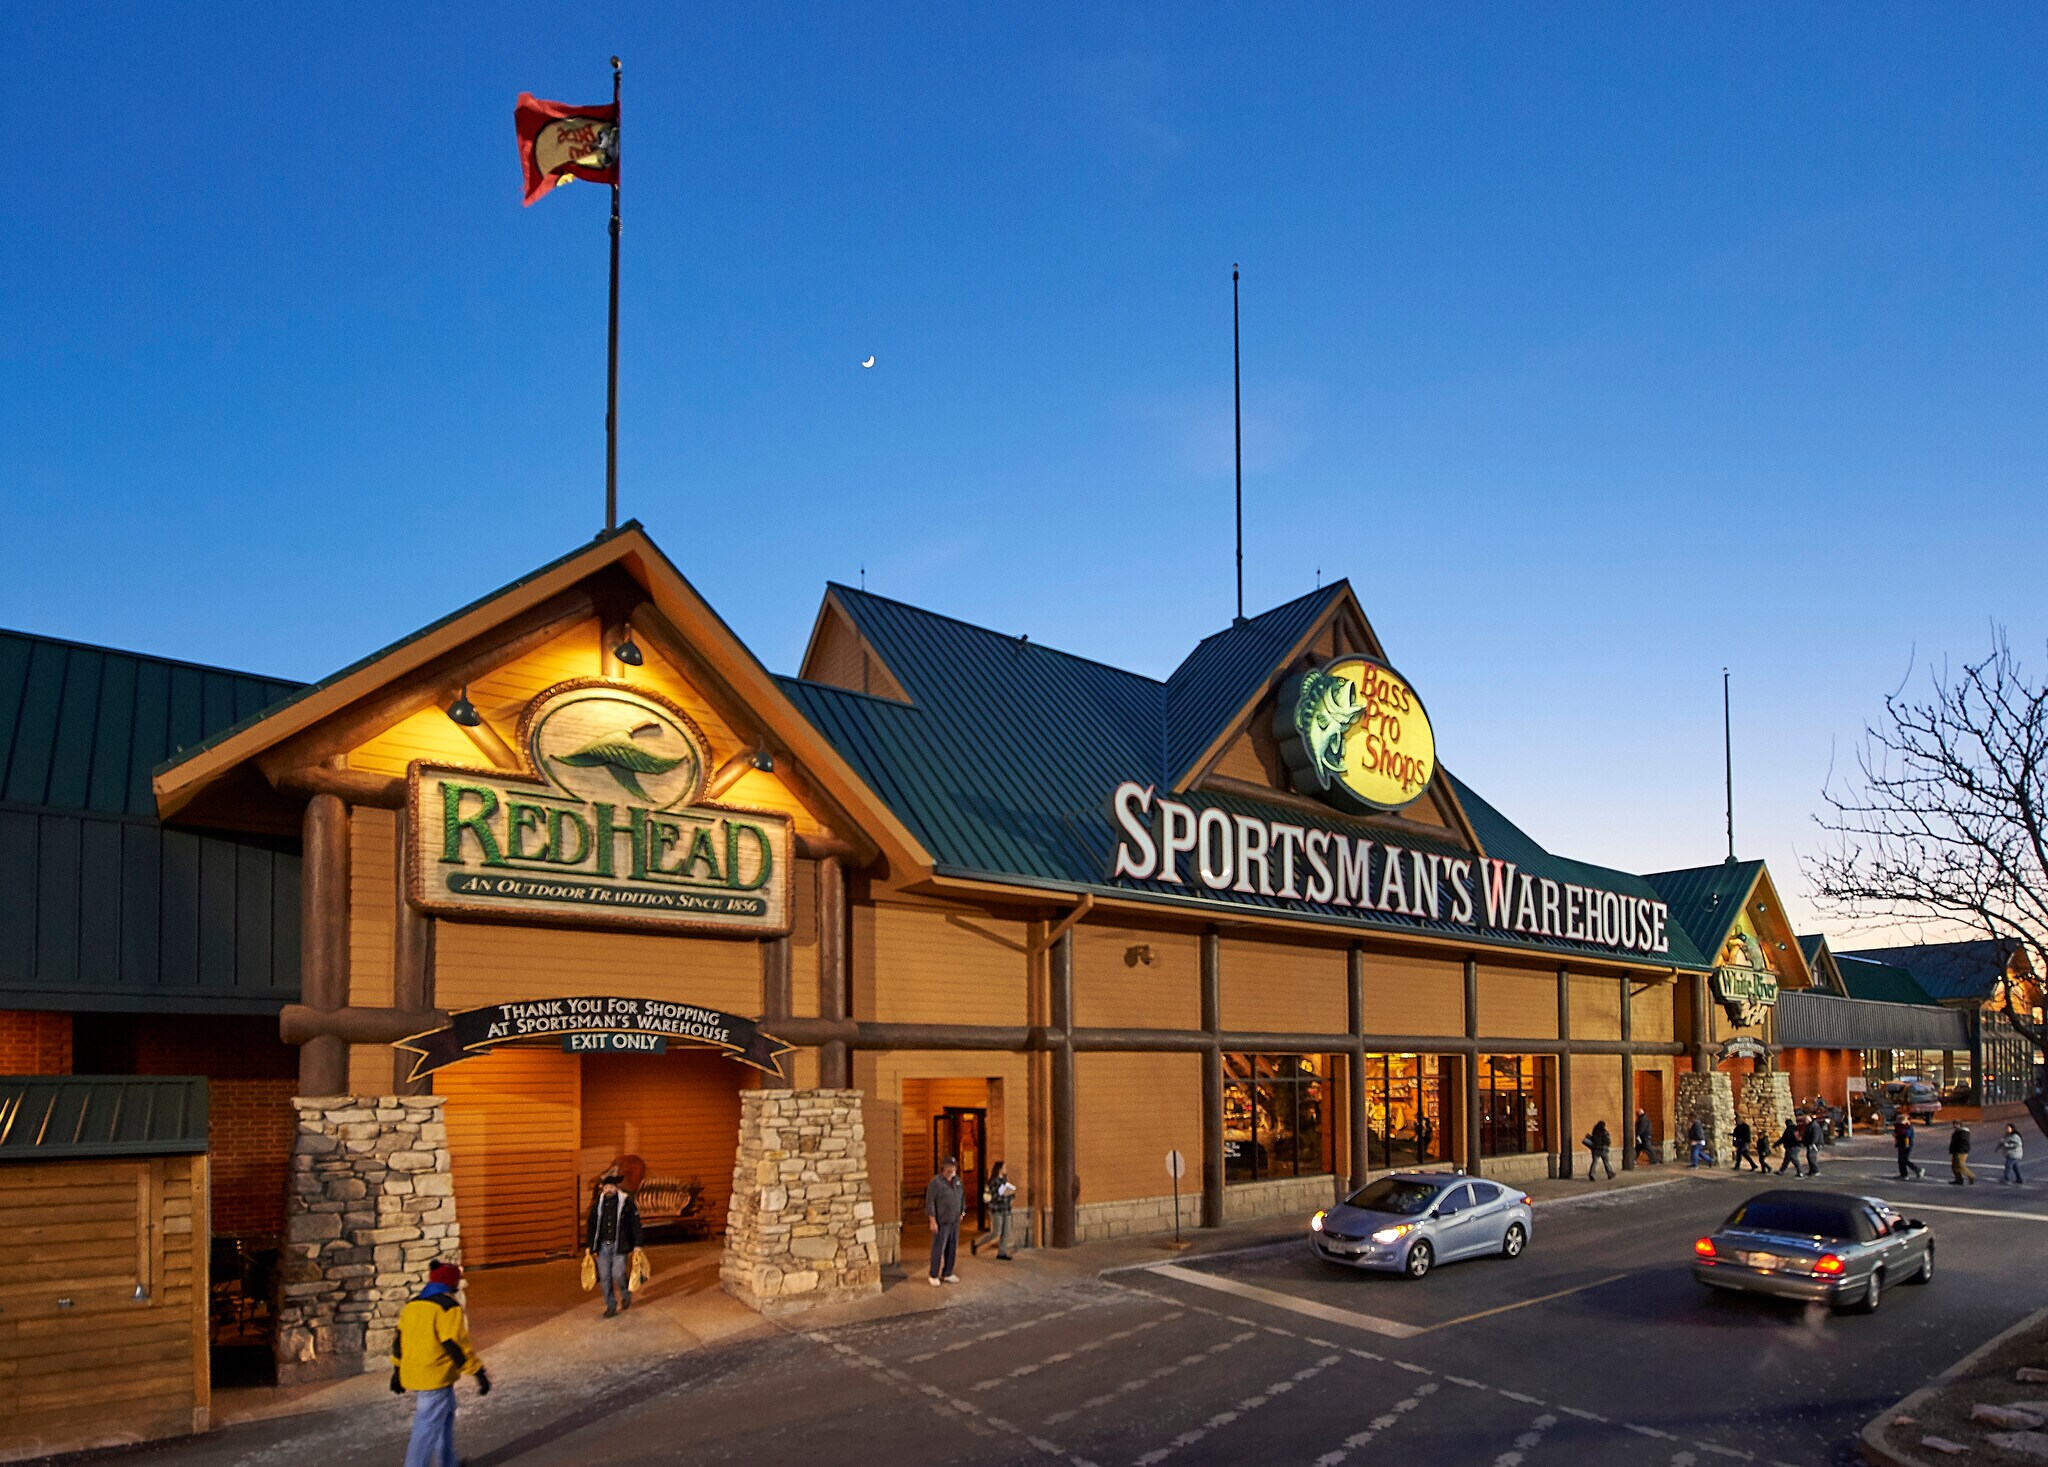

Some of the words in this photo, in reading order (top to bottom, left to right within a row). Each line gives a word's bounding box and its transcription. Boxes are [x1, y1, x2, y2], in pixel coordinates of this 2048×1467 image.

[1360, 662, 1410, 711] Bass
[1362, 697, 1400, 741] Pro
[1362, 734, 1425, 791] Shops
[1113, 781, 1473, 924] SPORTSMAN'S
[1479, 857, 1670, 953] WAREHOUSE
[460, 876, 494, 891] AN
[497, 879, 587, 899] OUTDOOR
[588, 887, 675, 906] TRADITION
[677, 893, 723, 910] SINCE
[726, 899, 758, 913] 1856
[487, 1021, 510, 1039] AT
[516, 1014, 630, 1034] SPORTSMAN'S
[636, 1014, 730, 1043] WAREHOUSE
[499, 1001, 563, 1020] THANK
[567, 999, 602, 1014] YOU
[607, 998, 638, 1014] FOR
[644, 1001, 720, 1026] SHOPPING
[571, 1033, 609, 1050] EXIT
[612, 1033, 659, 1050] ONLY
